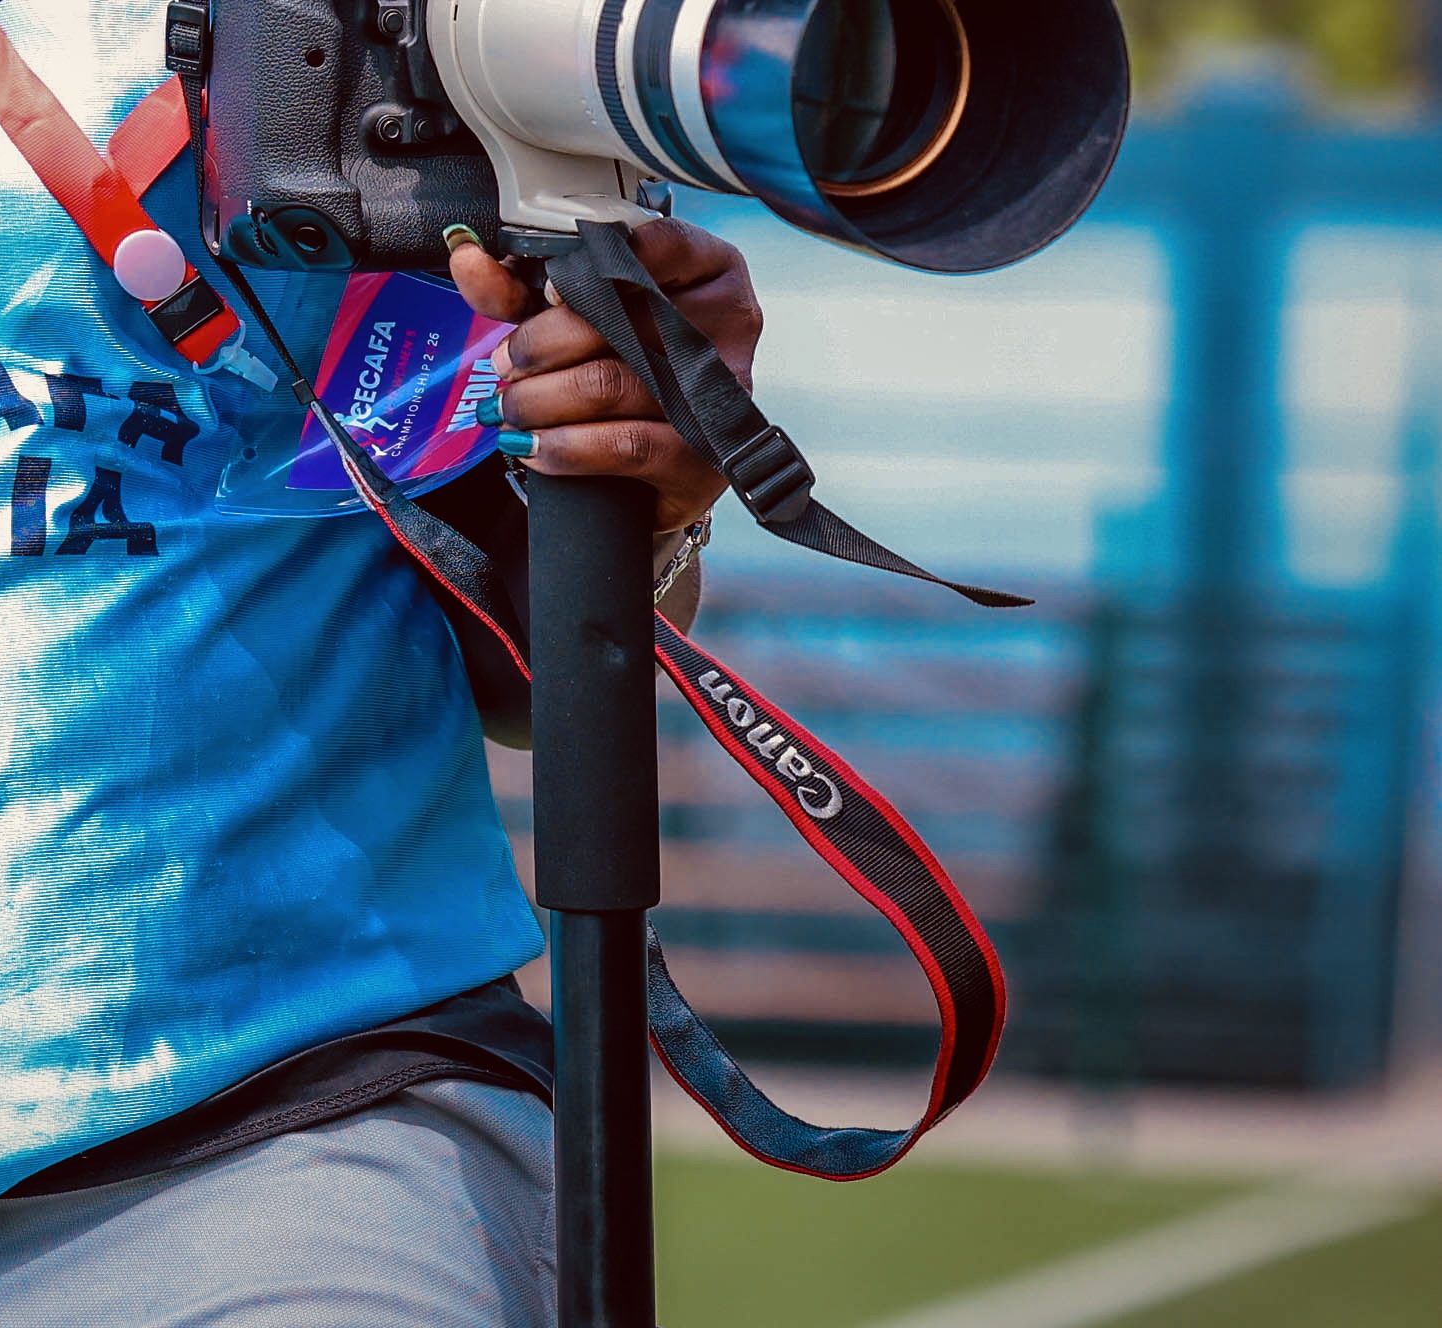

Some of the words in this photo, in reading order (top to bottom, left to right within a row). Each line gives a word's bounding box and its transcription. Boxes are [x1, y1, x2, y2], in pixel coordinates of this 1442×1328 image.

[350, 321, 396, 420] CECAFA
[391, 363, 431, 457] CHAMPIONSHIP
[698, 670, 843, 819] Canon
